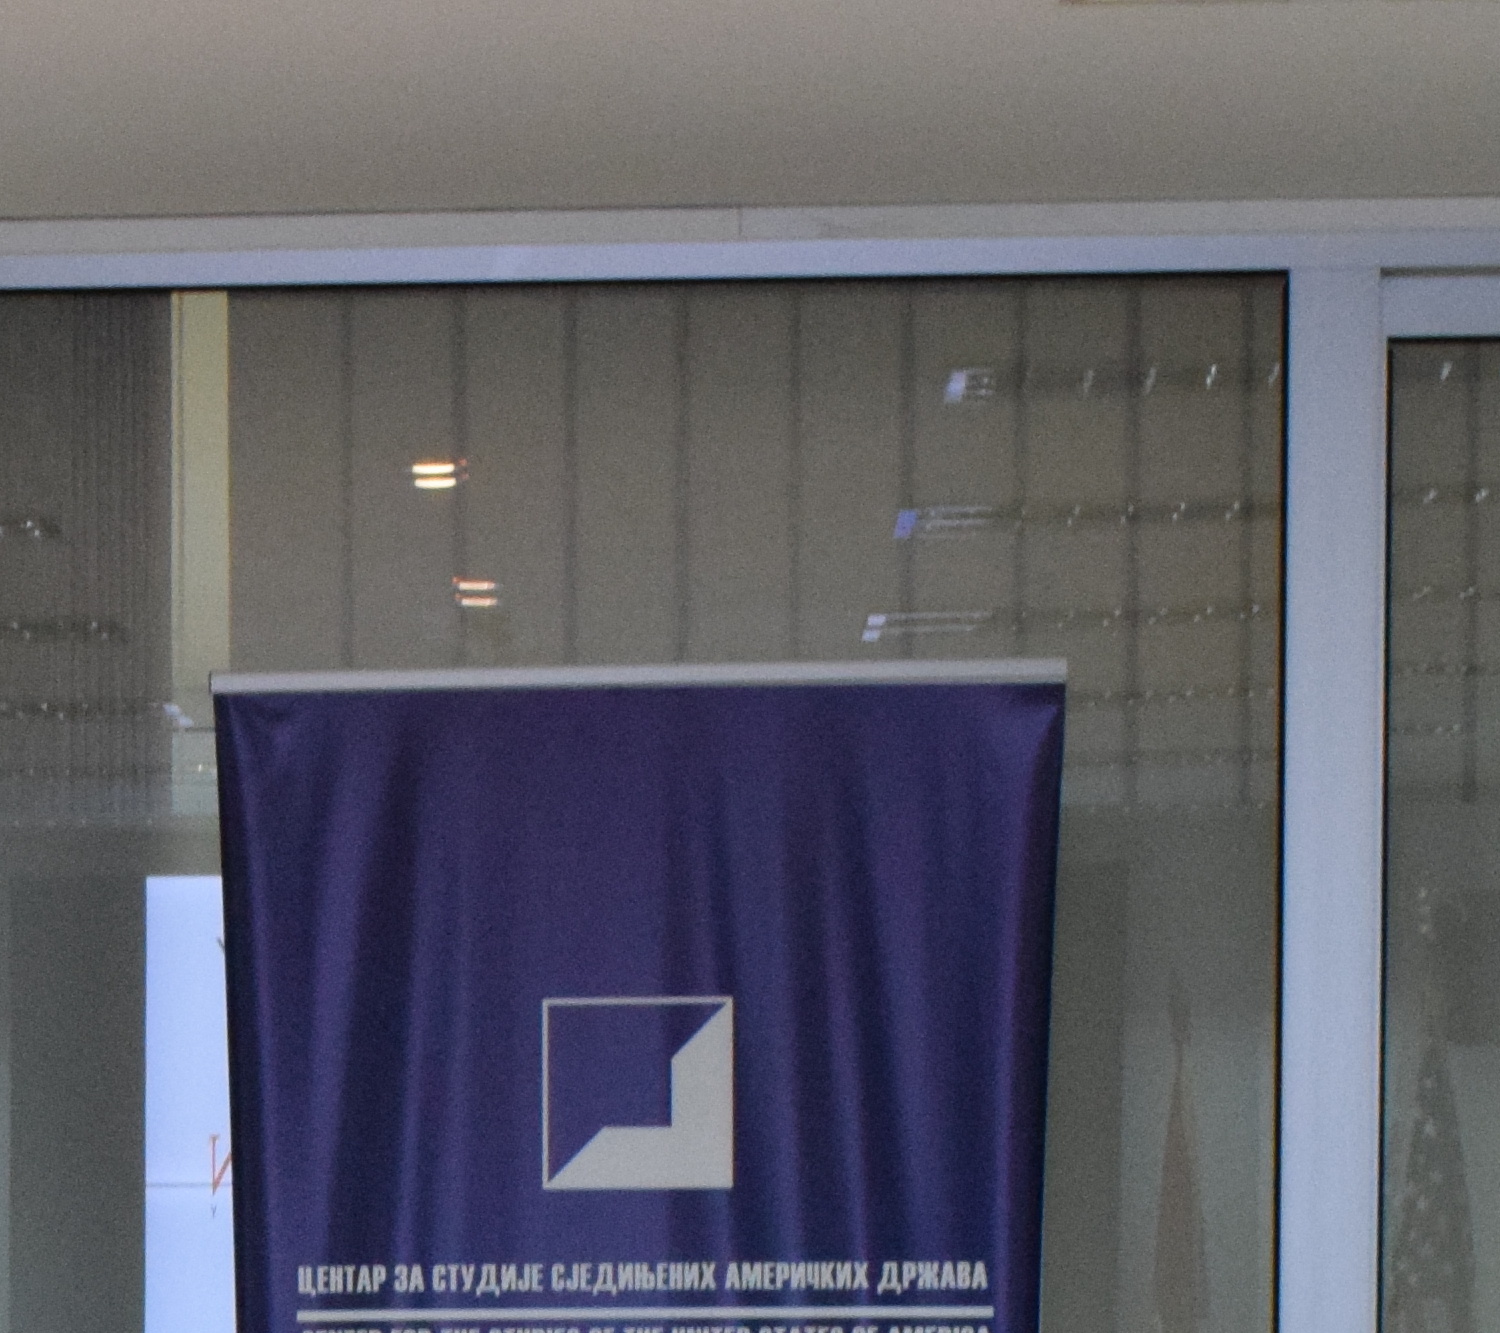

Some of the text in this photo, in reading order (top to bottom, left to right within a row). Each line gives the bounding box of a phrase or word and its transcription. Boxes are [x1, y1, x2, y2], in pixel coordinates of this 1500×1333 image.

[298, 1261, 988, 1297] ЦЕНТАР ЗА СТУДИЈЕ СЈЕДИЊЕНИХ АМЕРИЧКИХ ДРЖАВА
